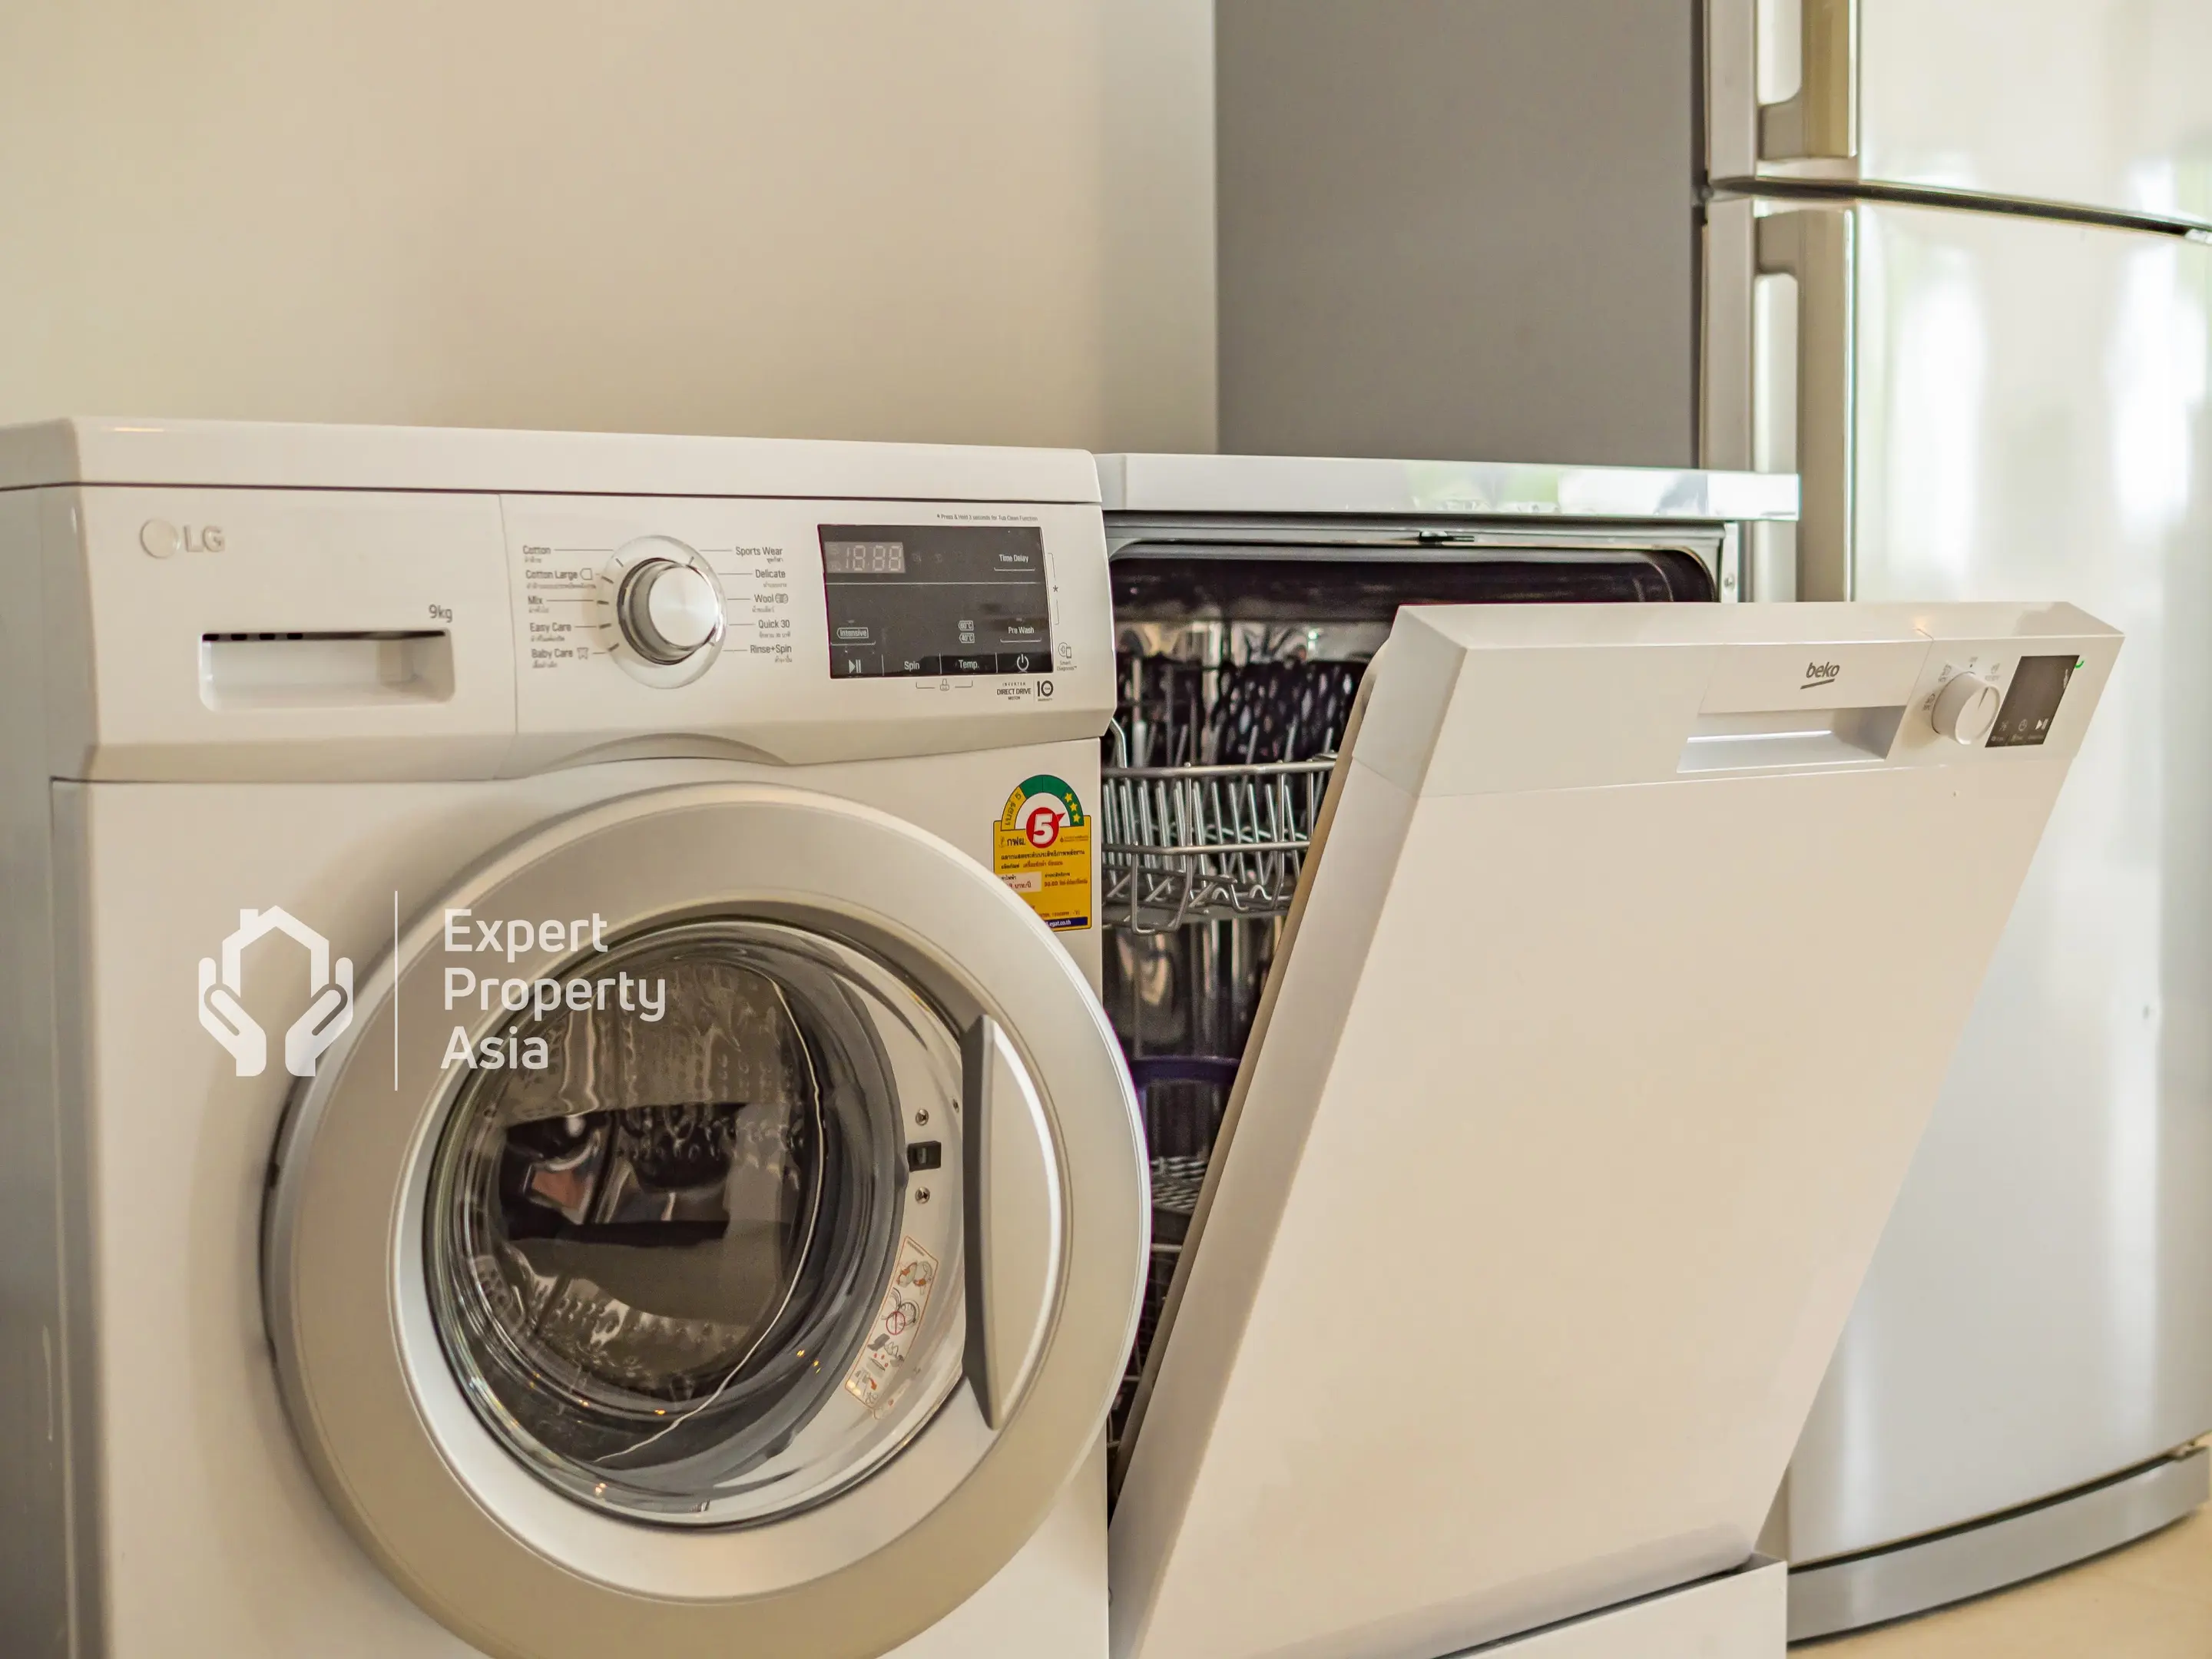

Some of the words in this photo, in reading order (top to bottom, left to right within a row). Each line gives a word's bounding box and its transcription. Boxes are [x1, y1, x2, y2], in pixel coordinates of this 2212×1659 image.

[184, 525, 225, 553] LG
[736, 546, 761, 557] Sports
[763, 546, 783, 555] Wear
[998, 554, 1012, 562] Time
[1014, 555, 1029, 563] Delay
[526, 570, 553, 578] Cotton
[555, 571, 578, 581] Large
[755, 569, 786, 578] Delicate
[754, 594, 773, 603] Wool
[429, 604, 452, 623] 9kg
[758, 620, 779, 628] Quick
[780, 620, 790, 628] 30
[839, 628, 867, 637] Intensive
[531, 648, 552, 659] Baby
[554, 648, 573, 657] Care
[750, 644, 792, 654] Rinse+Spin
[904, 661, 920, 671] Spin
[958, 660, 980, 670] Temp.
[1806, 661, 1840, 678] beko
[1033, 813, 1054, 845] 5
